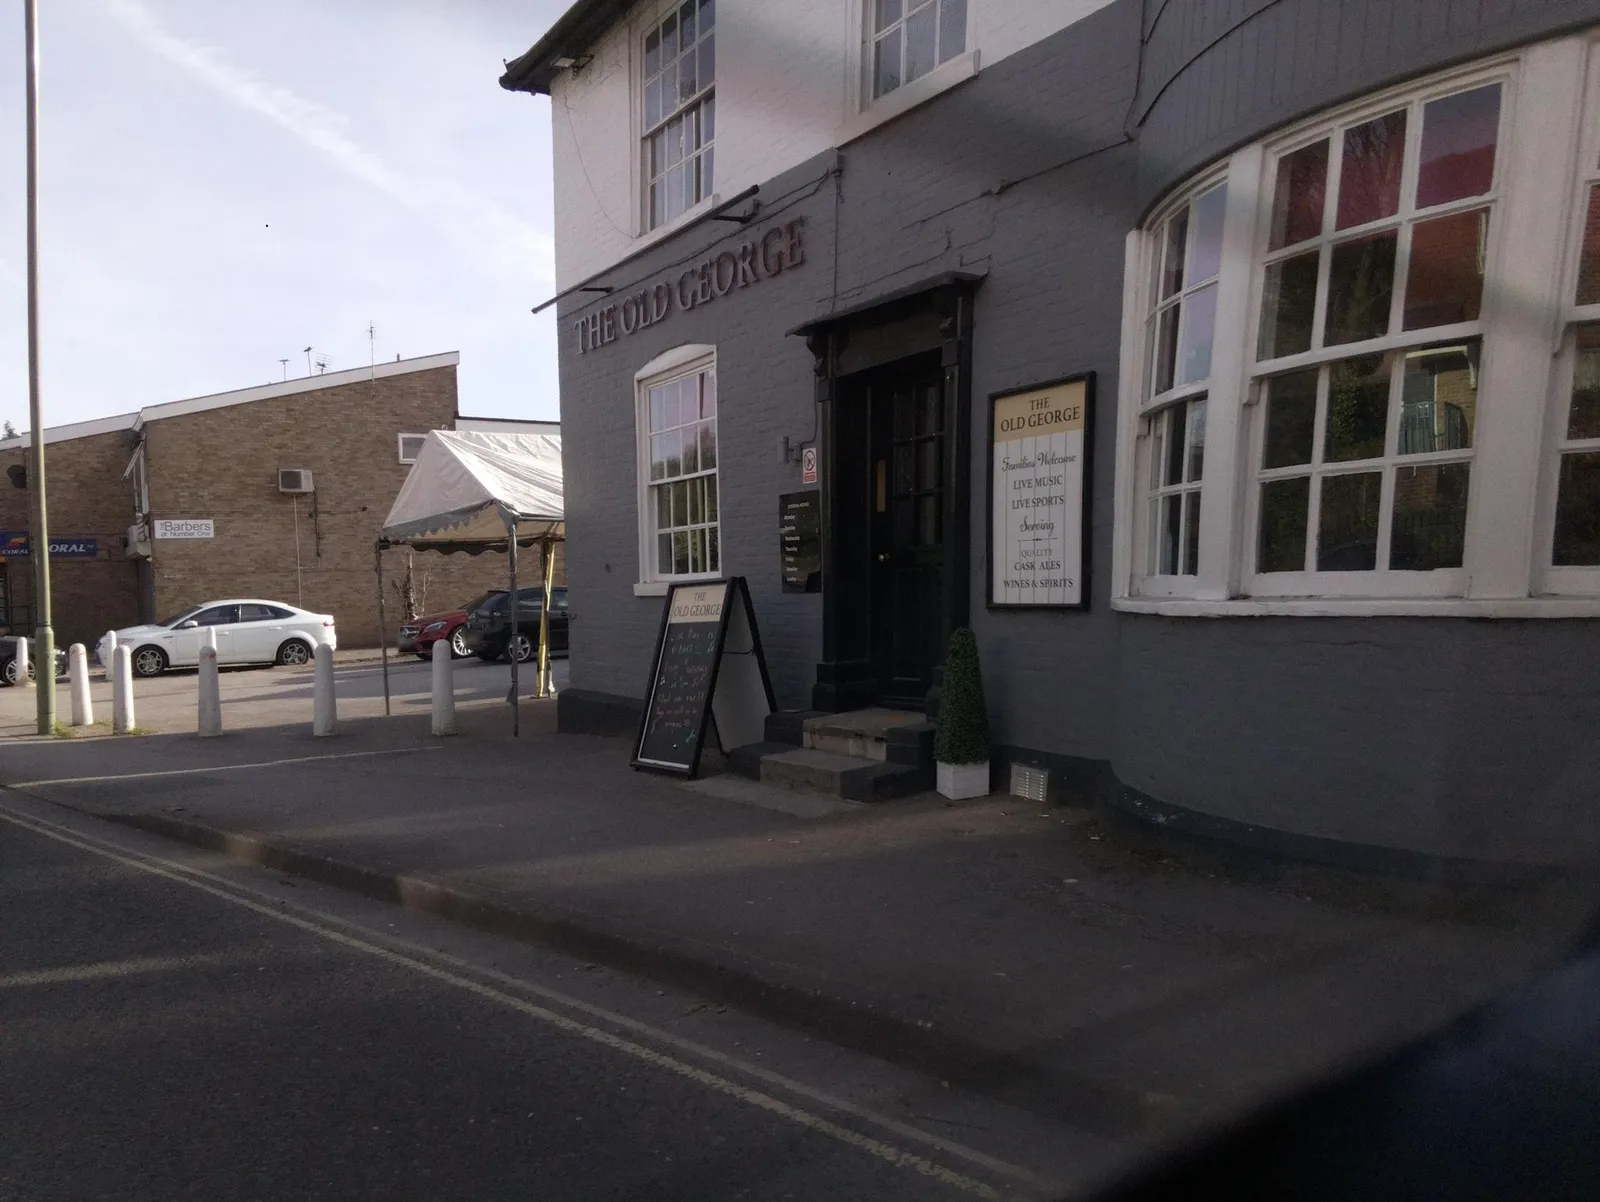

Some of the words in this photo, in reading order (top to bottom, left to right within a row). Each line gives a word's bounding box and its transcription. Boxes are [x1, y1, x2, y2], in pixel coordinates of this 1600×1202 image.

[574, 304, 617, 354] THE
[620, 282, 673, 335] OLD
[678, 217, 806, 311] GEORGE
[1029, 397, 1051, 411] THE
[1001, 416, 1026, 433] OLD
[1028, 406, 1080, 428] GEORGE
[1002, 456, 1036, 472] Families
[1037, 452, 1076, 466] Welcome
[1013, 478, 1033, 490] LIVE
[1035, 474, 1063, 488] MUSIC
[1012, 499, 1031, 510] LIVE
[1031, 495, 1065, 508] SPORTS
[164, 521, 211, 532] Barbers
[1019, 516, 1055, 537] Serving
[48, 543, 86, 553] ORAL
[1021, 548, 1053, 559] QUALITY
[1014, 561, 1036, 571] CASK
[1038, 560, 1061, 570] ALES
[1003, 579, 1030, 589] WINES
[1031, 579, 1038, 588] &
[1039, 578, 1074, 588] SPIRITS
[694, 592, 706, 601] THE
[674, 605, 689, 617] OLD
[690, 603, 721, 616] GEORGE
